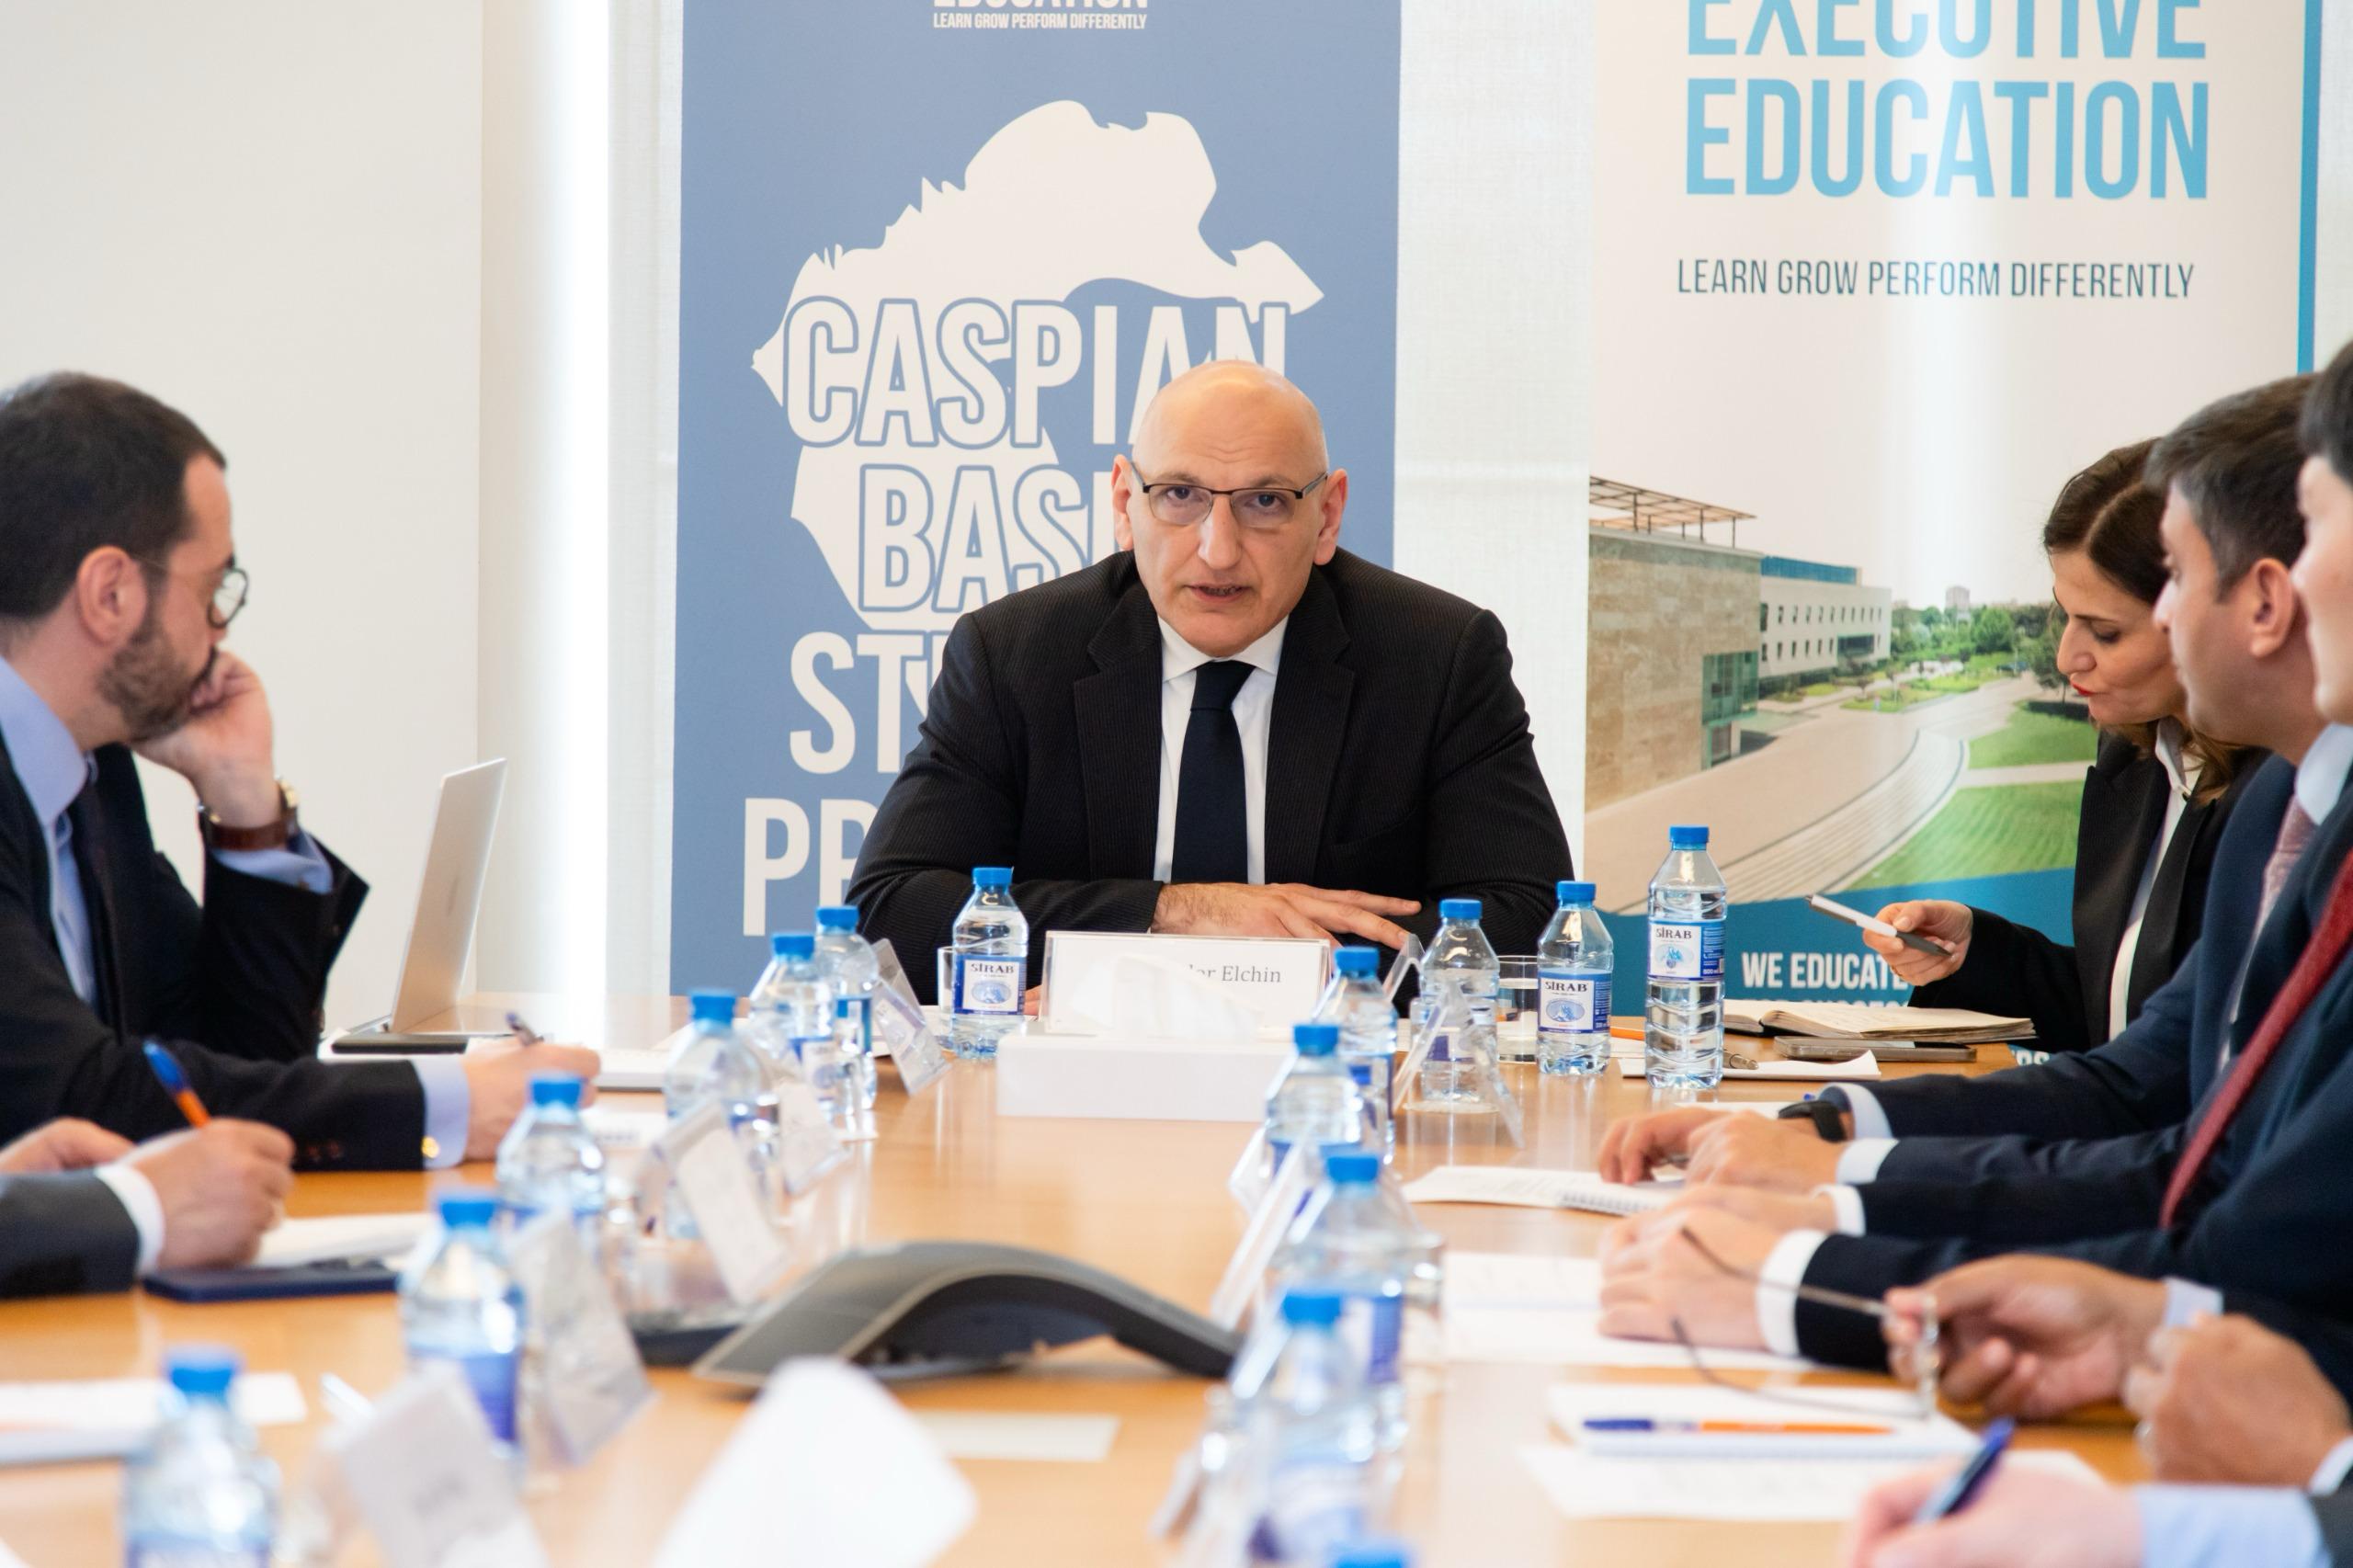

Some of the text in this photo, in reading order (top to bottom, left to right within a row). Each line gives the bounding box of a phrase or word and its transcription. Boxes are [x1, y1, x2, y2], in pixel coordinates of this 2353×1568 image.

[934, 13, 1147, 29] LEARN GROW PERFORM DIFFERENTLY
[1687, 78, 2209, 199] EDUCATION
[1677, 258, 2195, 298] LEARN GROW PERFORM DIFFERENTLY
[1222, 964, 1281, 983] Elchin
[1742, 952, 1783, 988] WE
